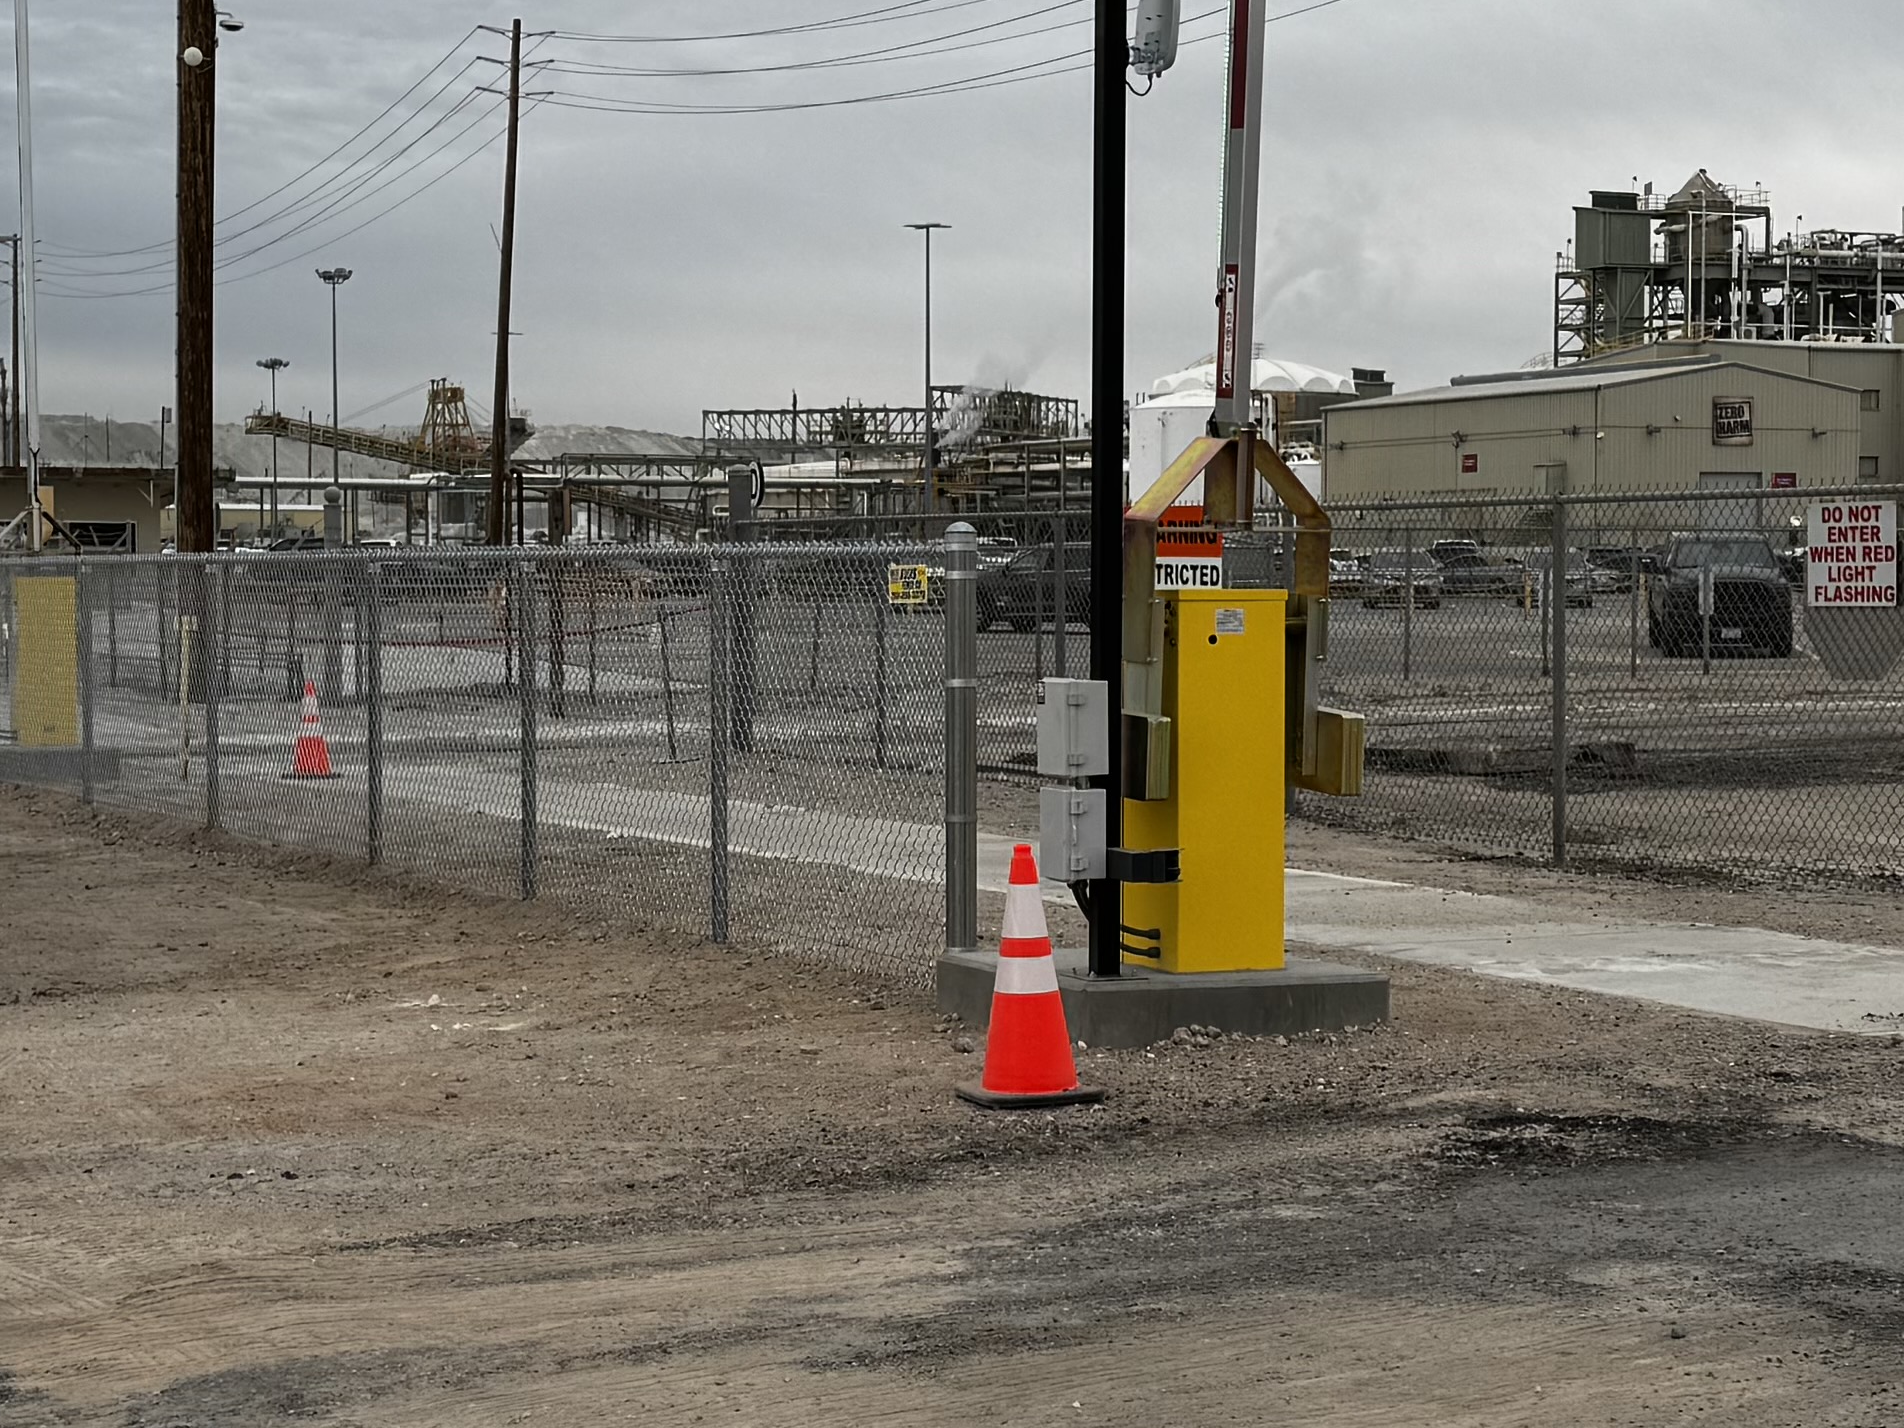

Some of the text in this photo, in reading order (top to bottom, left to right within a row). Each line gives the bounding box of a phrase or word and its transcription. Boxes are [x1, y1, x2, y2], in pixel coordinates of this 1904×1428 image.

[1718, 405, 1745, 420] ZERO
[1717, 420, 1750, 435] HARM
[1821, 504, 1883, 524] DO NOT
[1156, 519, 1218, 545] ARNING
[1827, 525, 1881, 543] ENTER
[1809, 544, 1895, 563] WHEN RED
[1155, 563, 1220, 587] TRICTED
[1827, 565, 1877, 583] LIGHT
[1814, 585, 1895, 603] FLASHING
